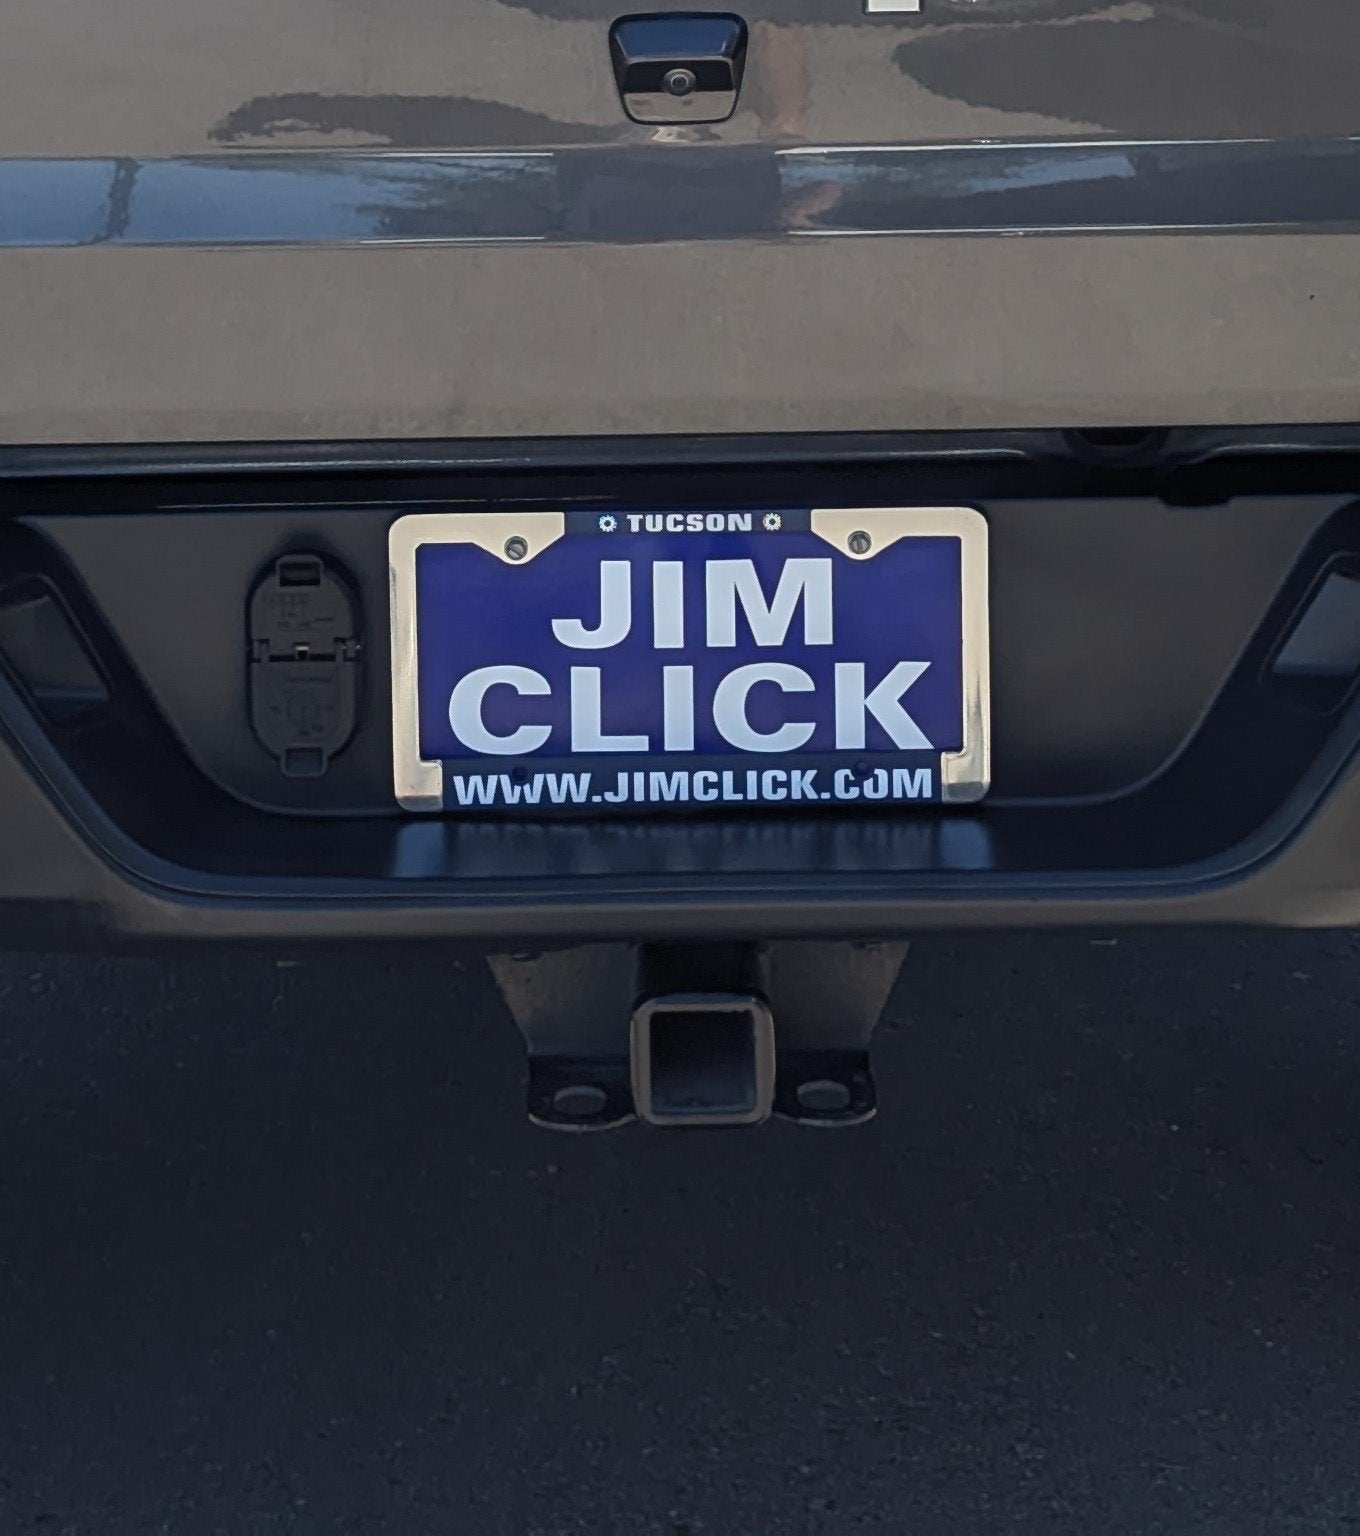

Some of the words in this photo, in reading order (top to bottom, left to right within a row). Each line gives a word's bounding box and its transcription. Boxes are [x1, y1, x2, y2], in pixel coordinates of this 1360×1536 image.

[627, 513, 752, 532] TUCSON
[551, 558, 833, 649] JIM
[448, 661, 934, 754] CLICK
[453, 768, 933, 805] WWW.JIMCLICK.COM
